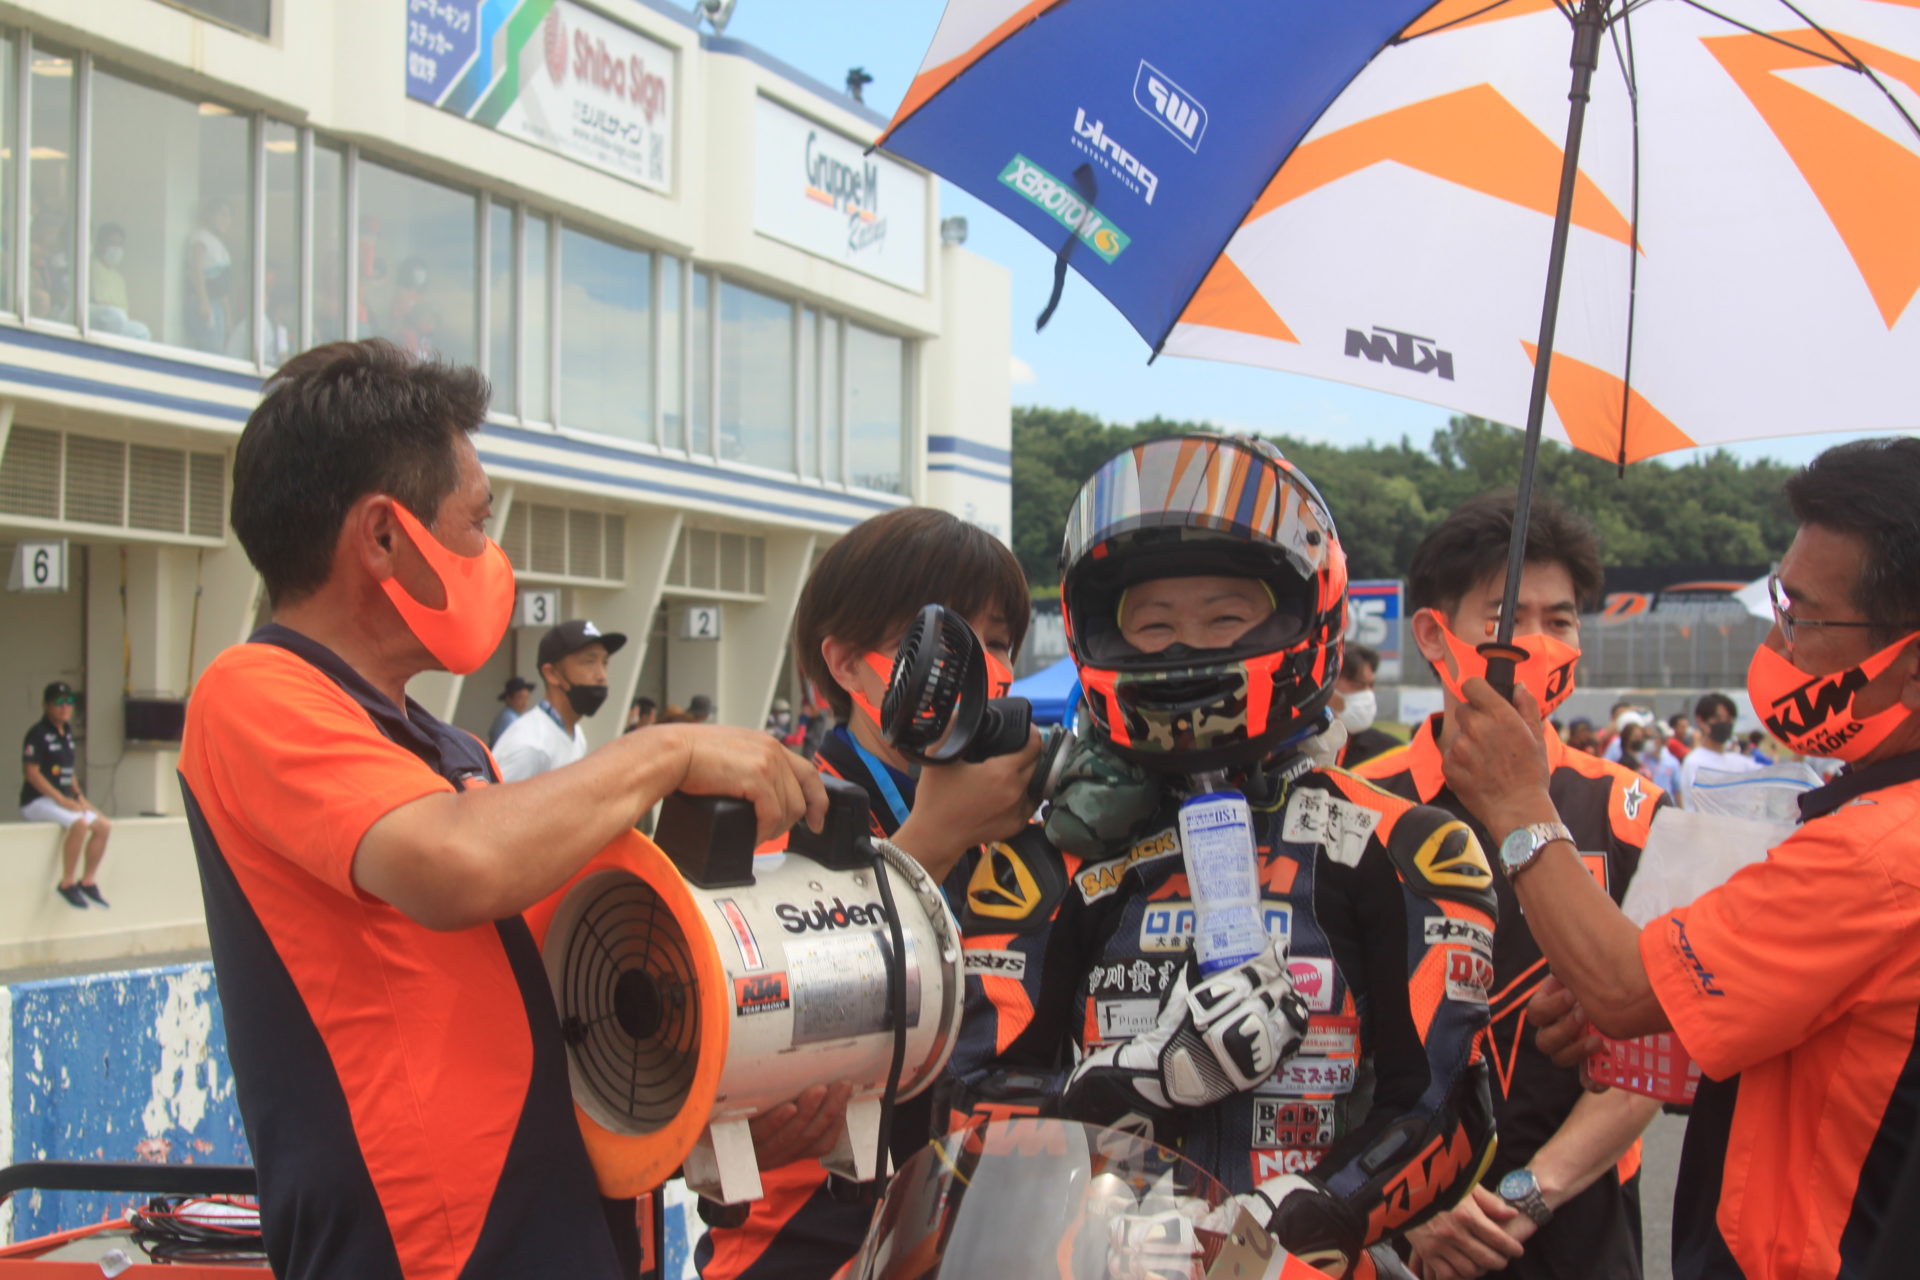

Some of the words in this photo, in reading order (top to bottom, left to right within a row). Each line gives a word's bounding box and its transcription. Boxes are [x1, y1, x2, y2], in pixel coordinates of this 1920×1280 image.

[573, 27, 626, 98] Shiba
[630, 53, 665, 127] Sign
[33, 549, 49, 584] 6
[533, 596, 547, 622] 3
[699, 611, 711, 636] 2
[1764, 665, 1870, 743] KTM
[775, 896, 888, 933] Suiden
[742, 977, 782, 1003] KTM
[948, 1102, 1068, 1156] KTM
[1260, 1103, 1331, 1123] Baby
[1260, 1126, 1330, 1144] Face
[1364, 1121, 1472, 1246] KTM
